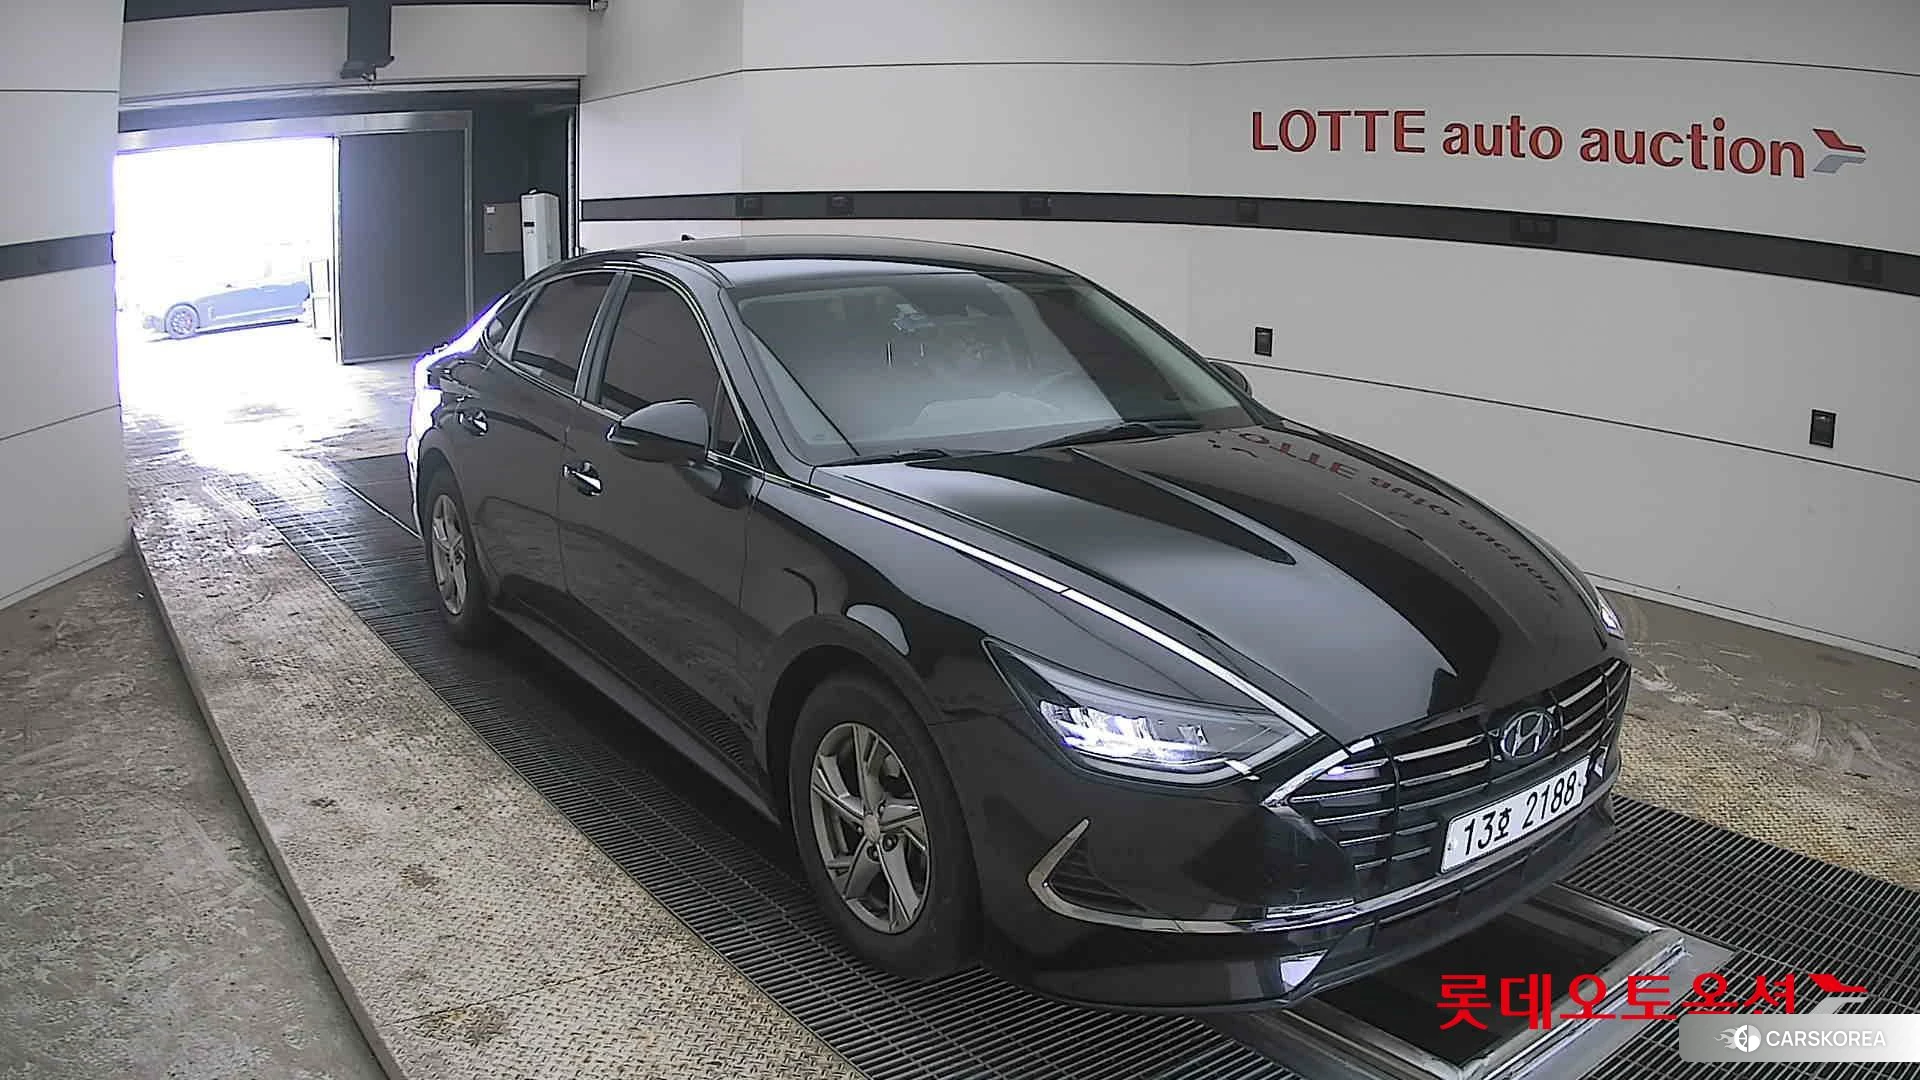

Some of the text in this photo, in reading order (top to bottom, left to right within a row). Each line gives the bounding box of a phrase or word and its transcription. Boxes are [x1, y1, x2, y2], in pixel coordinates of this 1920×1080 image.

[1251, 109, 1806, 179] LOTTE auto auction
[1463, 769, 1578, 856] 13호 2188
